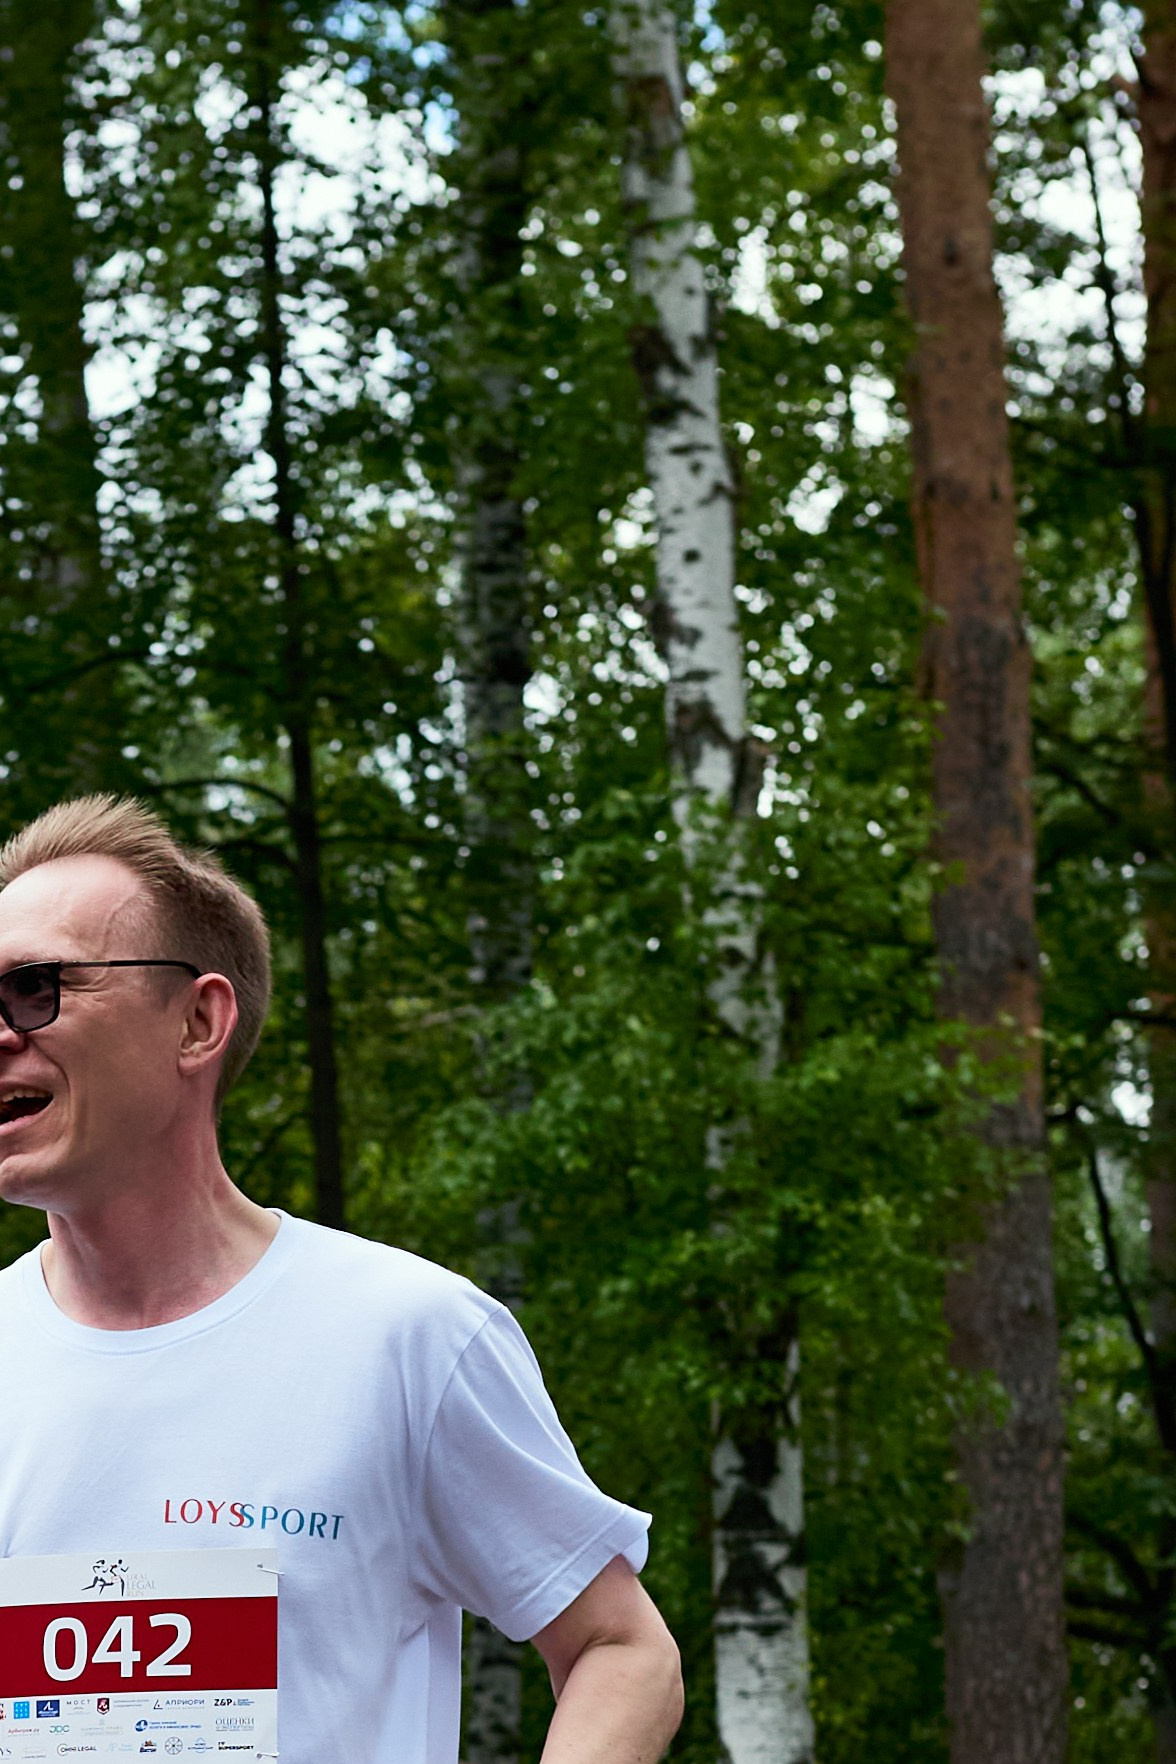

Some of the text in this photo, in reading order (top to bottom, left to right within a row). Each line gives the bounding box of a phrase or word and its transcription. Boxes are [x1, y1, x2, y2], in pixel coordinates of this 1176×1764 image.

[126, 1580, 157, 1590] LEGAL
[43, 1613, 192, 1682] 042
[214, 1698, 233, 1706] Z&P
